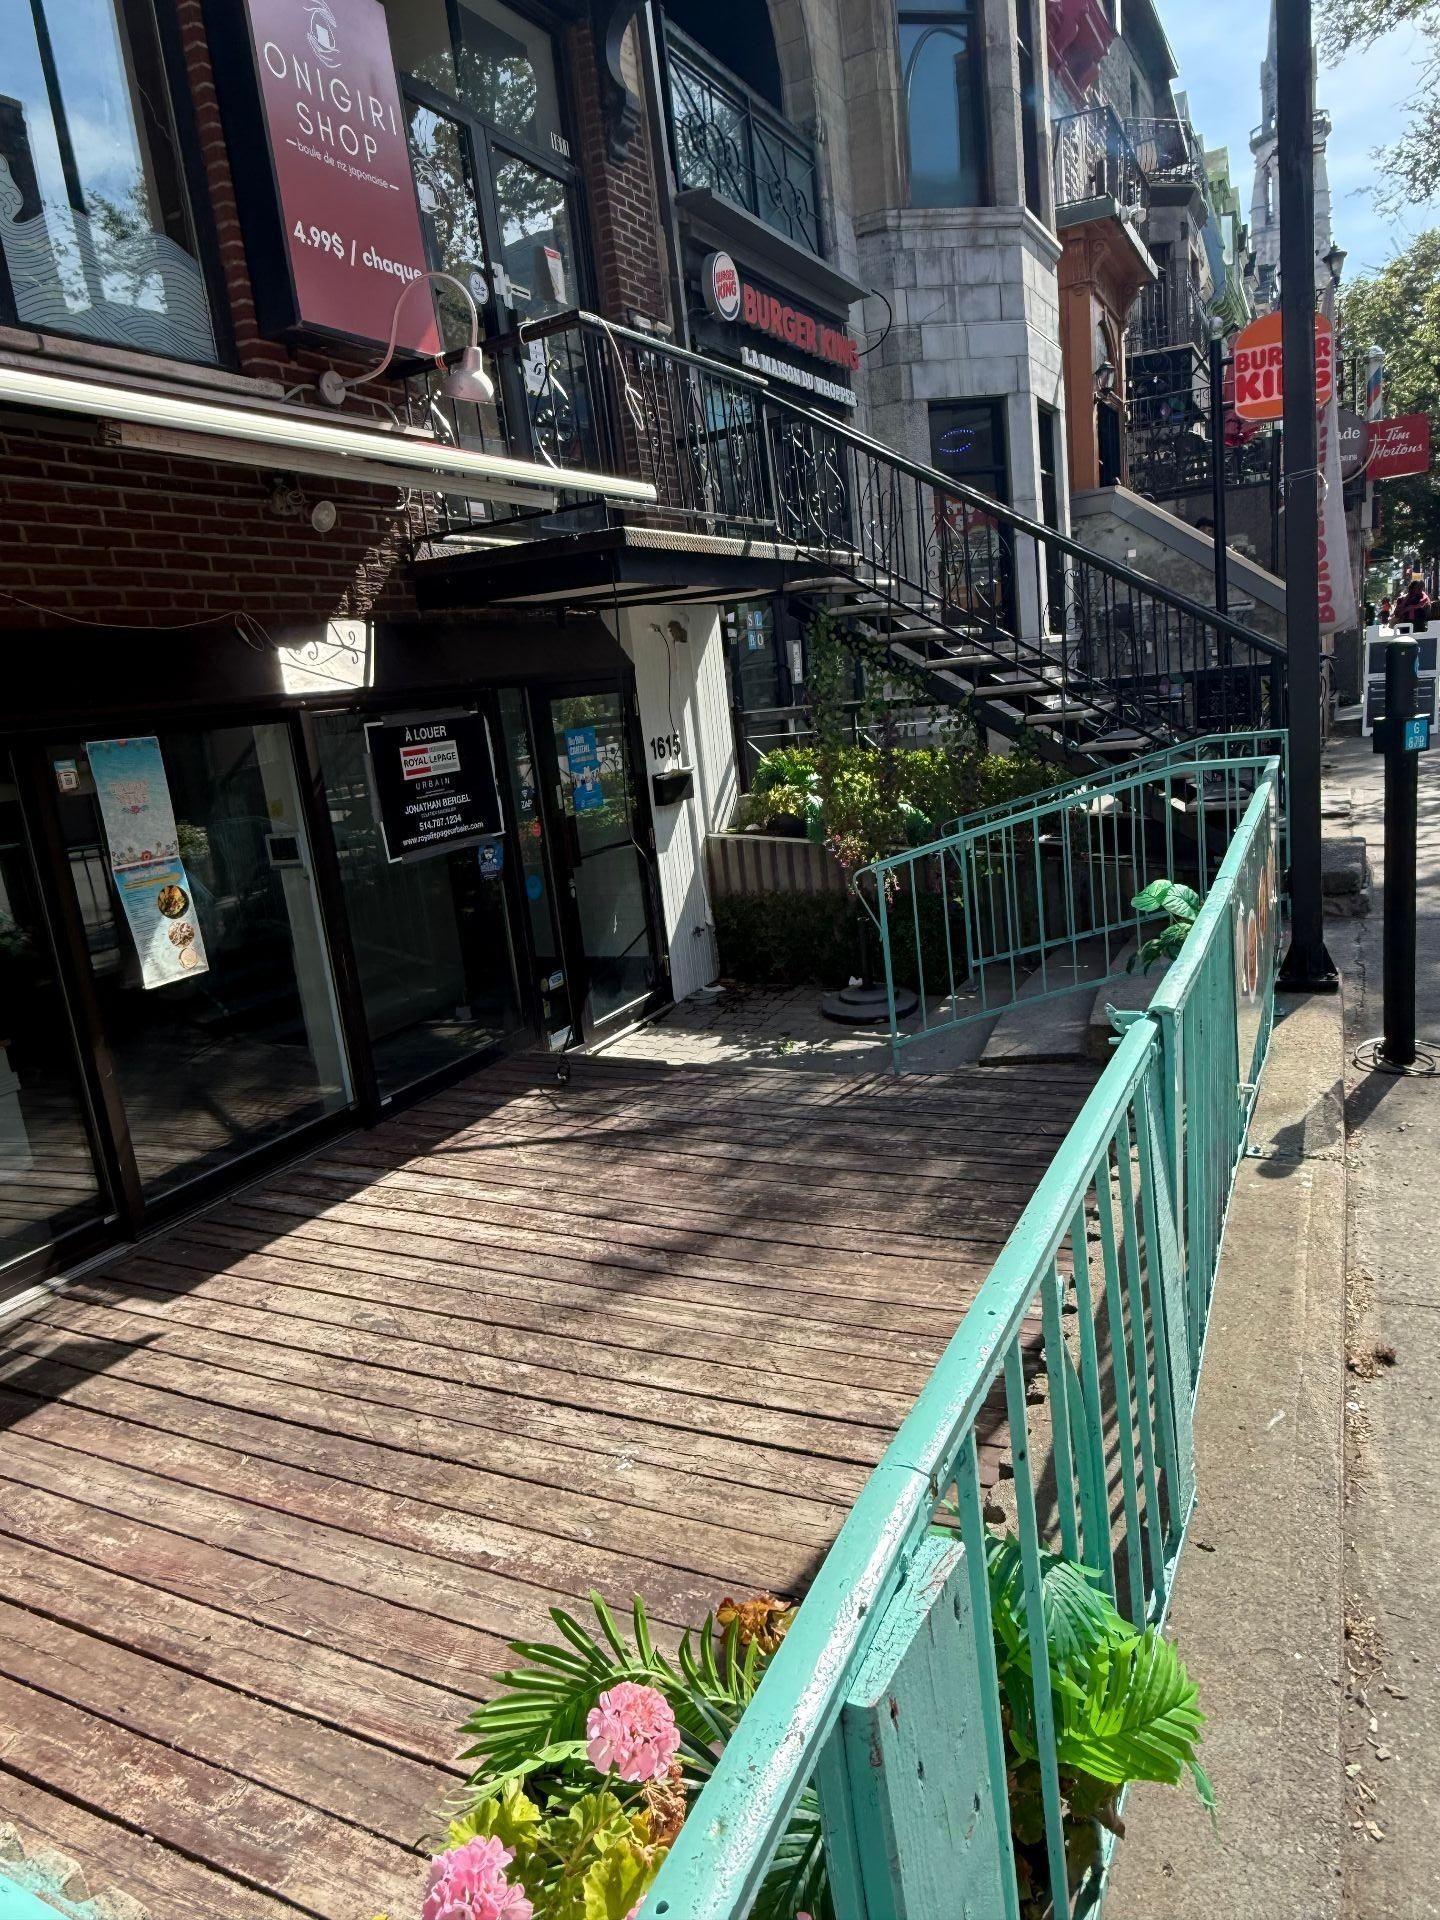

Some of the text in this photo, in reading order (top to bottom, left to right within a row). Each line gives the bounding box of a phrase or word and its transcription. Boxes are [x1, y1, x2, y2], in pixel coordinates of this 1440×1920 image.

[264, 41, 397, 136] ONIGIRI
[296, 101, 377, 162] SHOP
[296, 137, 389, 189] boule de riz japonaise
[293, 220, 423, 285] 4.99$ / chaque
[716, 280, 737, 301] KING
[743, 283, 860, 370] BURGER KING
[1235, 336, 1332, 374] BURR
[741, 347, 858, 407] LA MAISON DU WHOPPER
[1385, 425, 1411, 443] Tim
[1373, 443, 1424, 460] Hortons
[405, 725, 447, 742] À LOUER
[650, 733, 681, 760] 1615
[403, 757, 429, 769] ROYAL
[415, 777, 451, 791] URBAIN
[404, 799, 442, 815] JONATHAN
[442, 793, 472, 808] BERGEL
